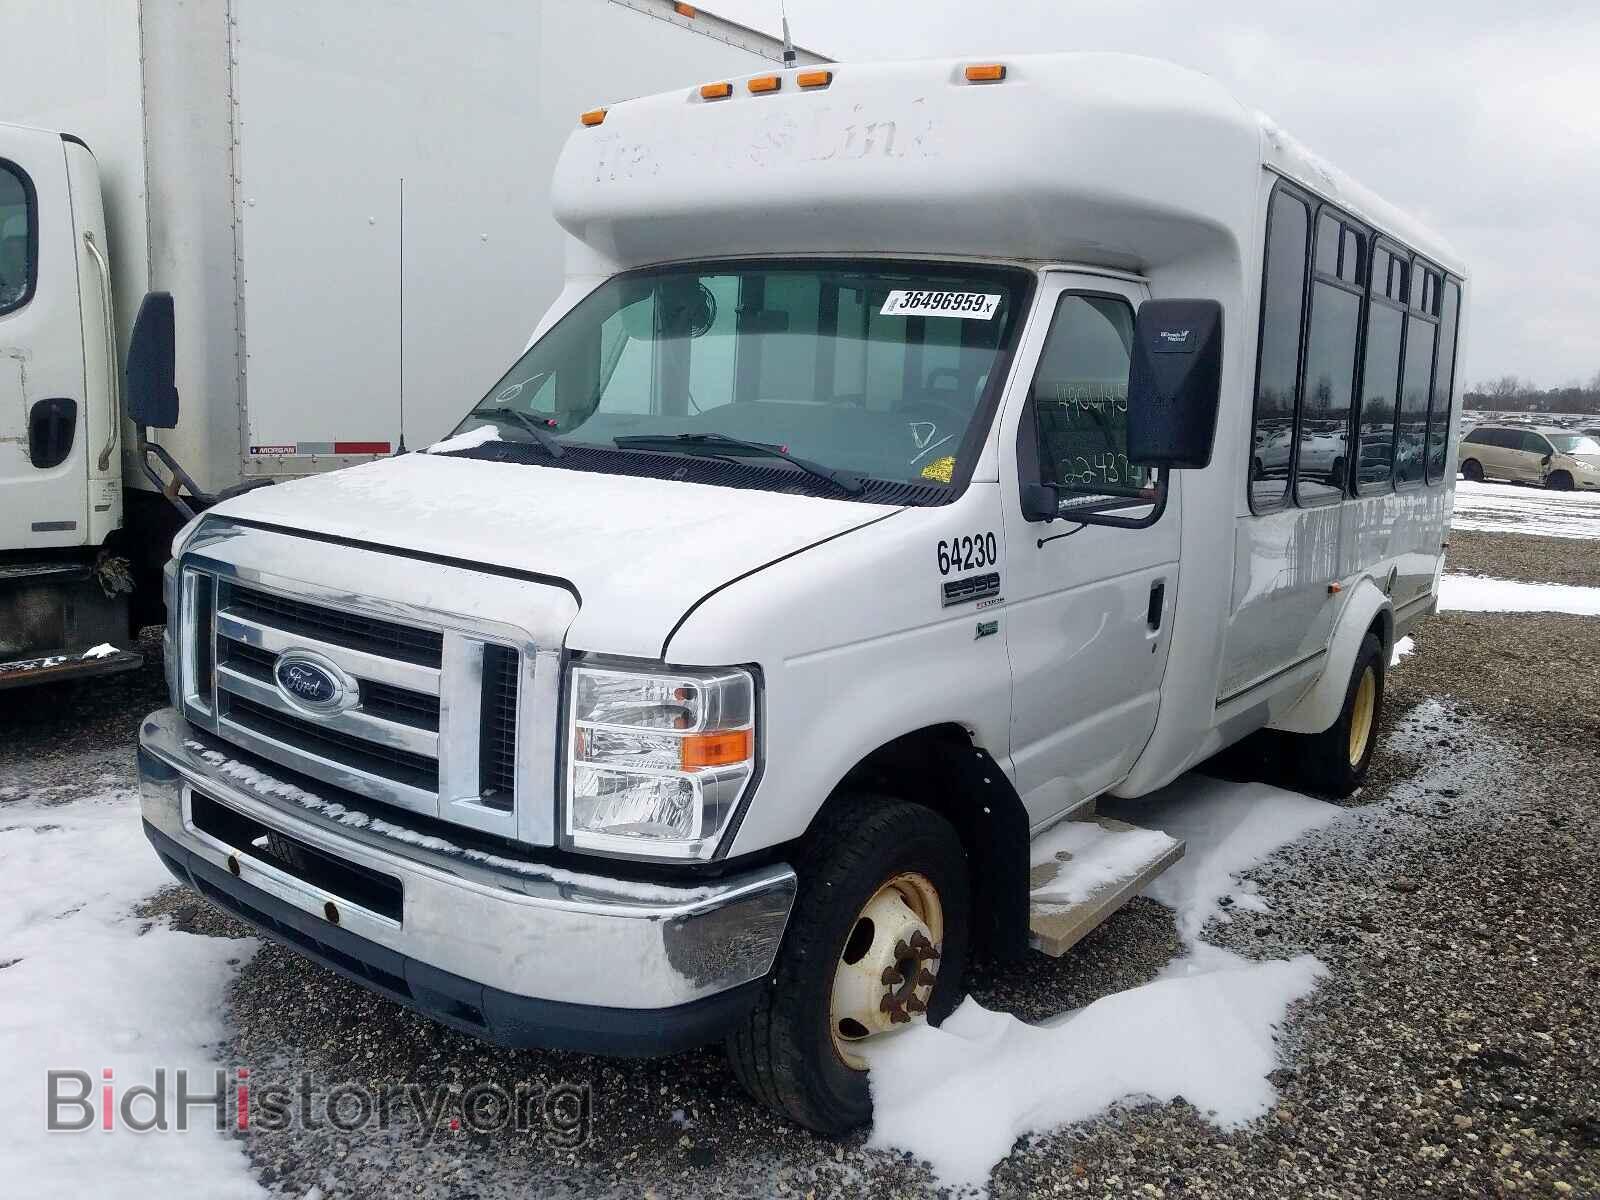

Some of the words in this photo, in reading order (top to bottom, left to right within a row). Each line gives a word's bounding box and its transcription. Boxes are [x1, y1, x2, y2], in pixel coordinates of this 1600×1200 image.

[259, 446, 295, 454] MORGAN
[937, 531, 997, 576] 64230
[286, 666, 321, 697] Ford
